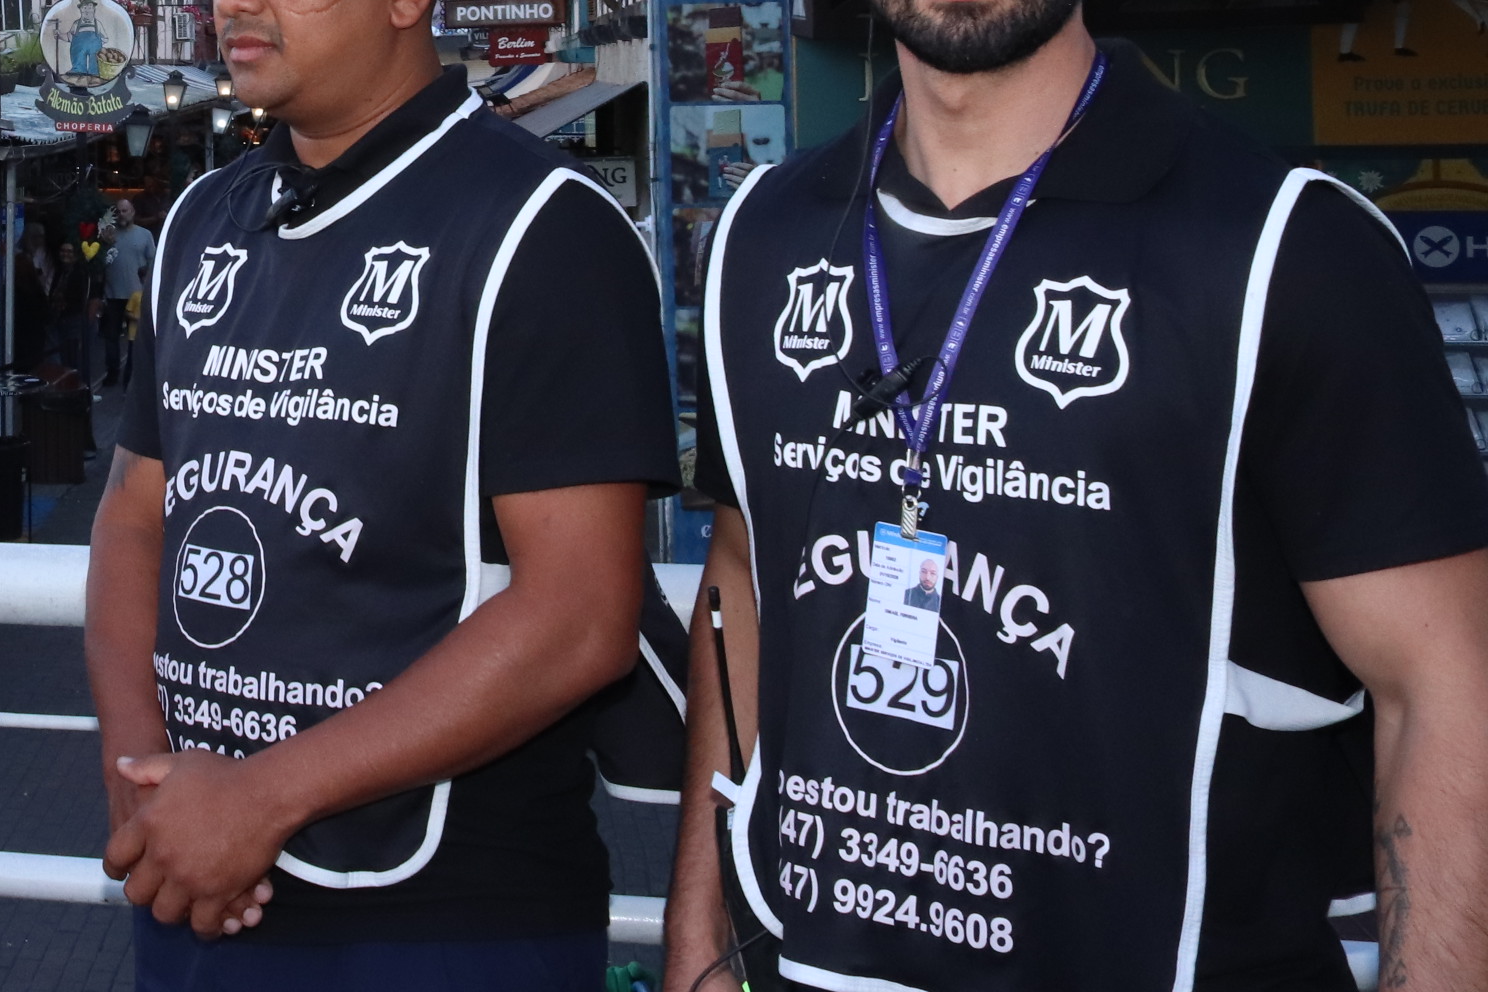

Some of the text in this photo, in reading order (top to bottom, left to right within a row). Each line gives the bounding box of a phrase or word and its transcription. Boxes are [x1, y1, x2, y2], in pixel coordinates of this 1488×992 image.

[456, 3, 553, 21] PONTINHO
[497, 36, 535, 49] Berlim
[47, 87, 123, 115] Alemão Batata
[1408, 100, 1428, 115] DE
[55, 122, 114, 132] CHOPERIA
[360, 260, 415, 305] M
[350, 304, 401, 320] Minister
[1040, 298, 1112, 358] M
[202, 345, 328, 384] MINISTER
[783, 333, 831, 353] Minister
[1030, 354, 1102, 379] Minister
[163, 381, 399, 428] Serviços de Vigilância
[833, 390, 1008, 448] MNTER
[774, 433, 882, 485] Serviços
[936, 454, 1110, 510] Vigilância
[181, 548, 250, 605] 528
[849, 648, 955, 719] 529
[174, 692, 297, 743] 3349-6636
[786, 775, 1110, 869] estou trabalhando?
[839, 827, 1014, 900] 3349-6636
[832, 879, 1014, 954] 9924.9608
